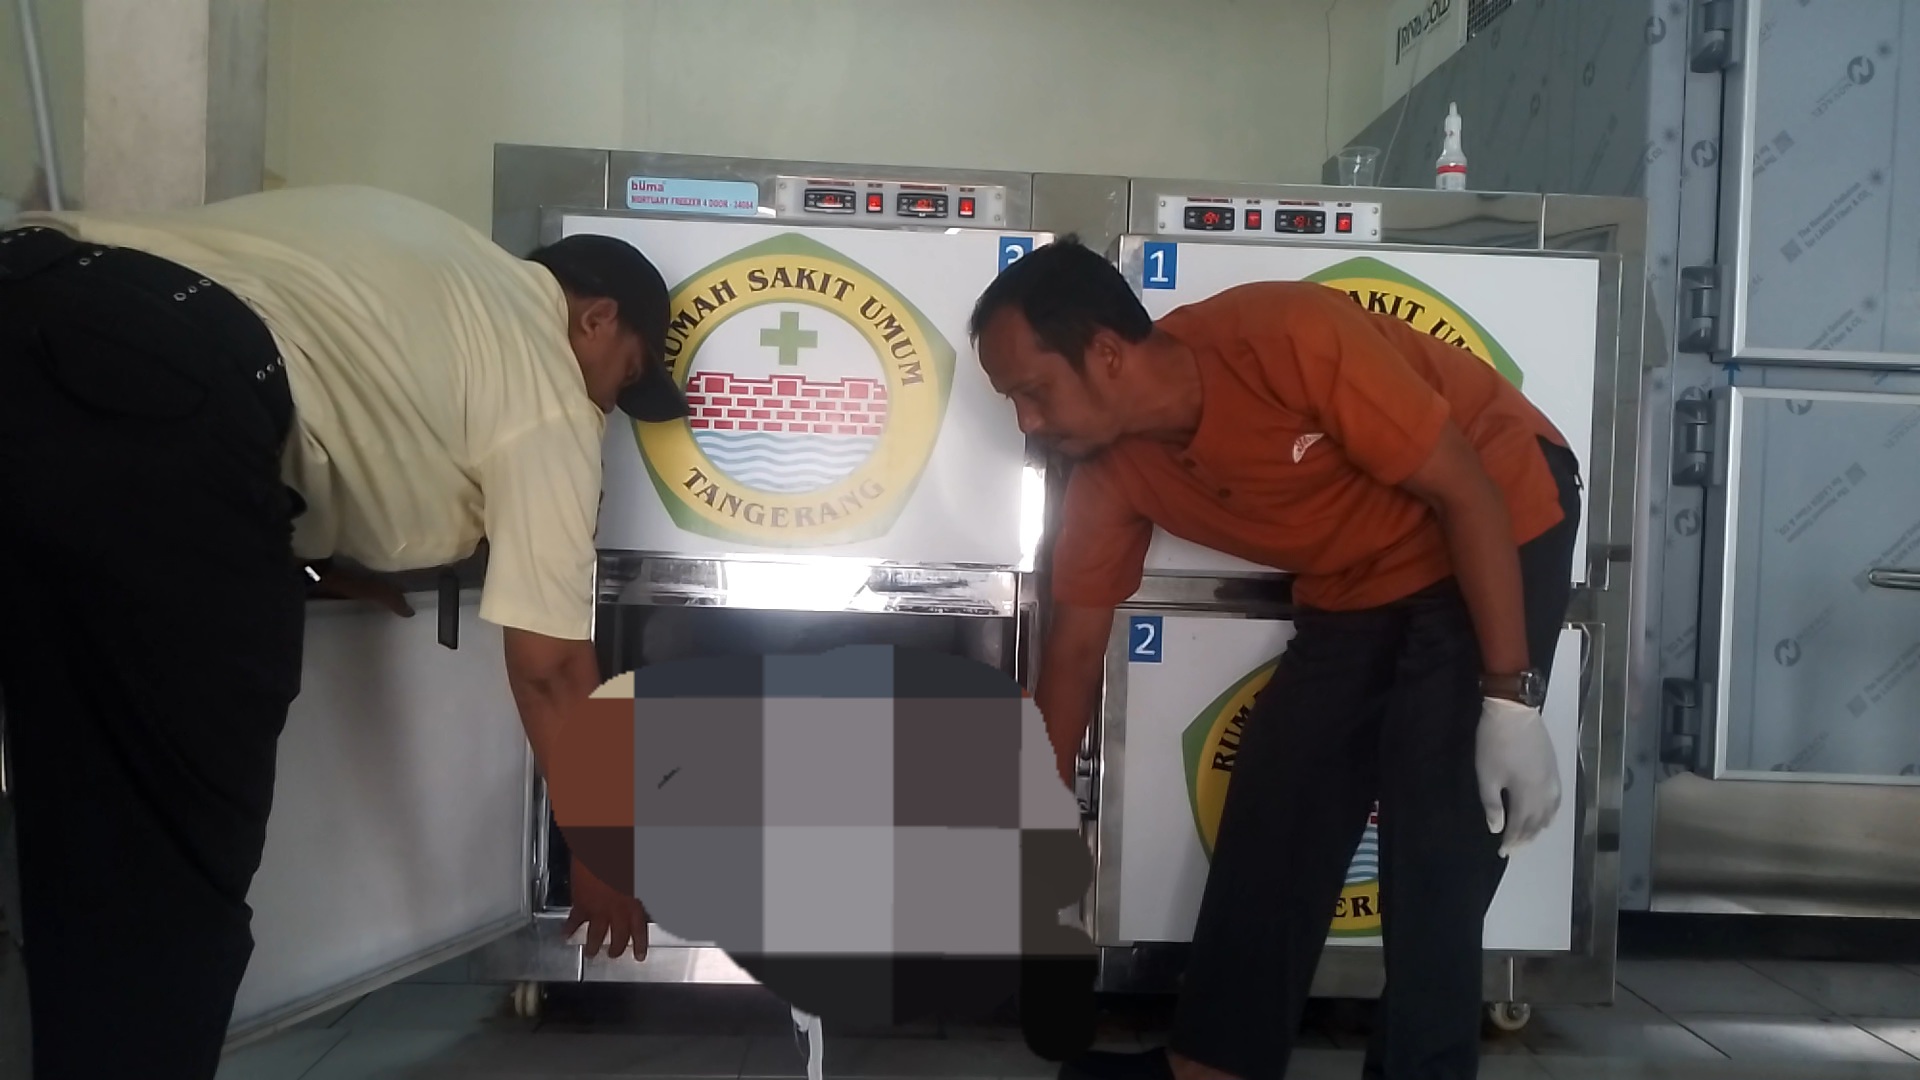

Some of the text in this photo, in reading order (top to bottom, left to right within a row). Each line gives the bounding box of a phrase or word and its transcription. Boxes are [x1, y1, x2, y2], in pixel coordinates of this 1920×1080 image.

[1150, 250, 1169, 283] 1
[747, 267, 855, 302] SAKIT
[859, 296, 924, 387] UMUM
[682, 467, 886, 528] TANGERANG
[1134, 623, 1156, 655] 2
[1211, 691, 1261, 773] RUM
[1332, 892, 1382, 918] ER
